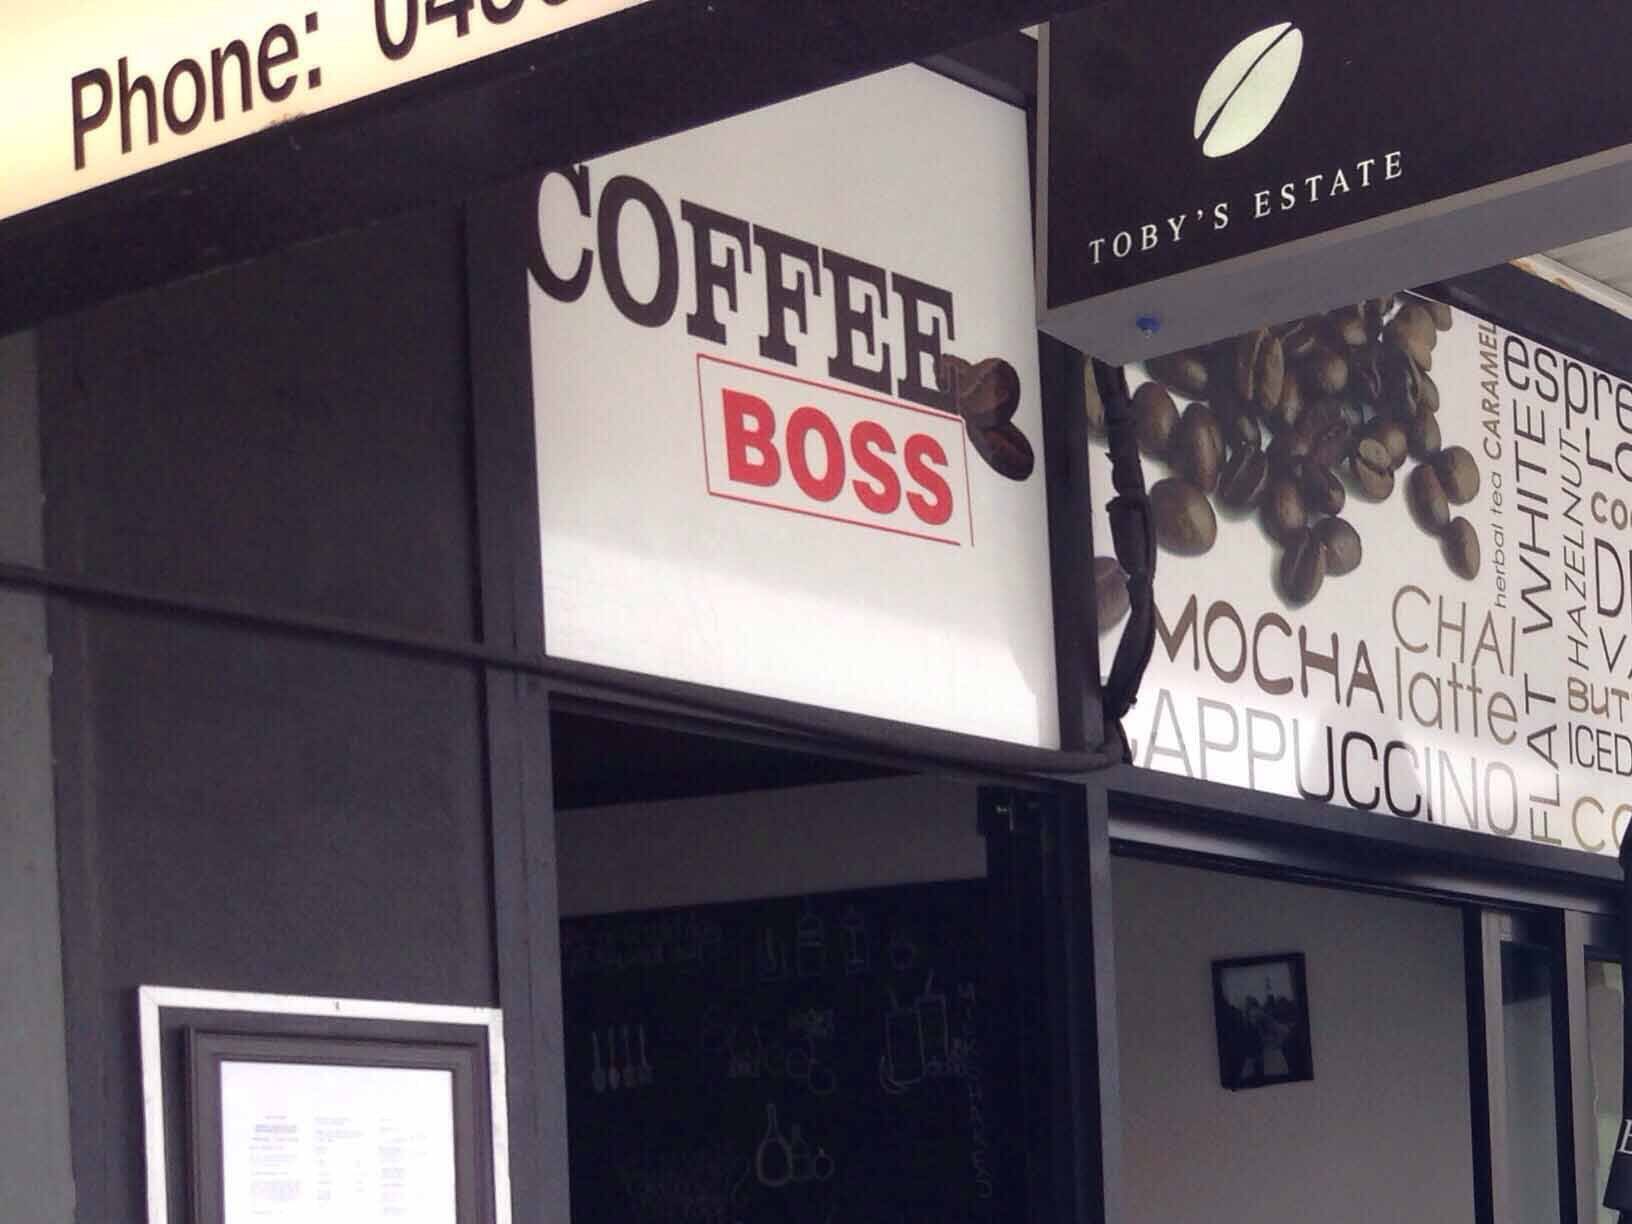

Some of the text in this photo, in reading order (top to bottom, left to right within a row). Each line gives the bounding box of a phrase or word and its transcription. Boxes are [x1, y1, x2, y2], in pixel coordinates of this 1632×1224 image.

[71, 11, 322, 170] Phone:
[1089, 150, 1403, 265] TOBY'S ESTATE
[528, 165, 963, 417] COFFEE
[722, 387, 954, 526] BOSS
[1479, 322, 1502, 460] CARAMEL
[1490, 471, 1507, 608] herbal tea
[1513, 398, 1553, 634] WHITE
[1558, 427, 1589, 671] HAZELNUT
[1152, 593, 1385, 714] MOCHA
[1392, 585, 1517, 677] CHAI
[1395, 647, 1519, 745] latte
[1131, 689, 1519, 836] APPUCCINO
[1524, 673, 1561, 846] FLAT
